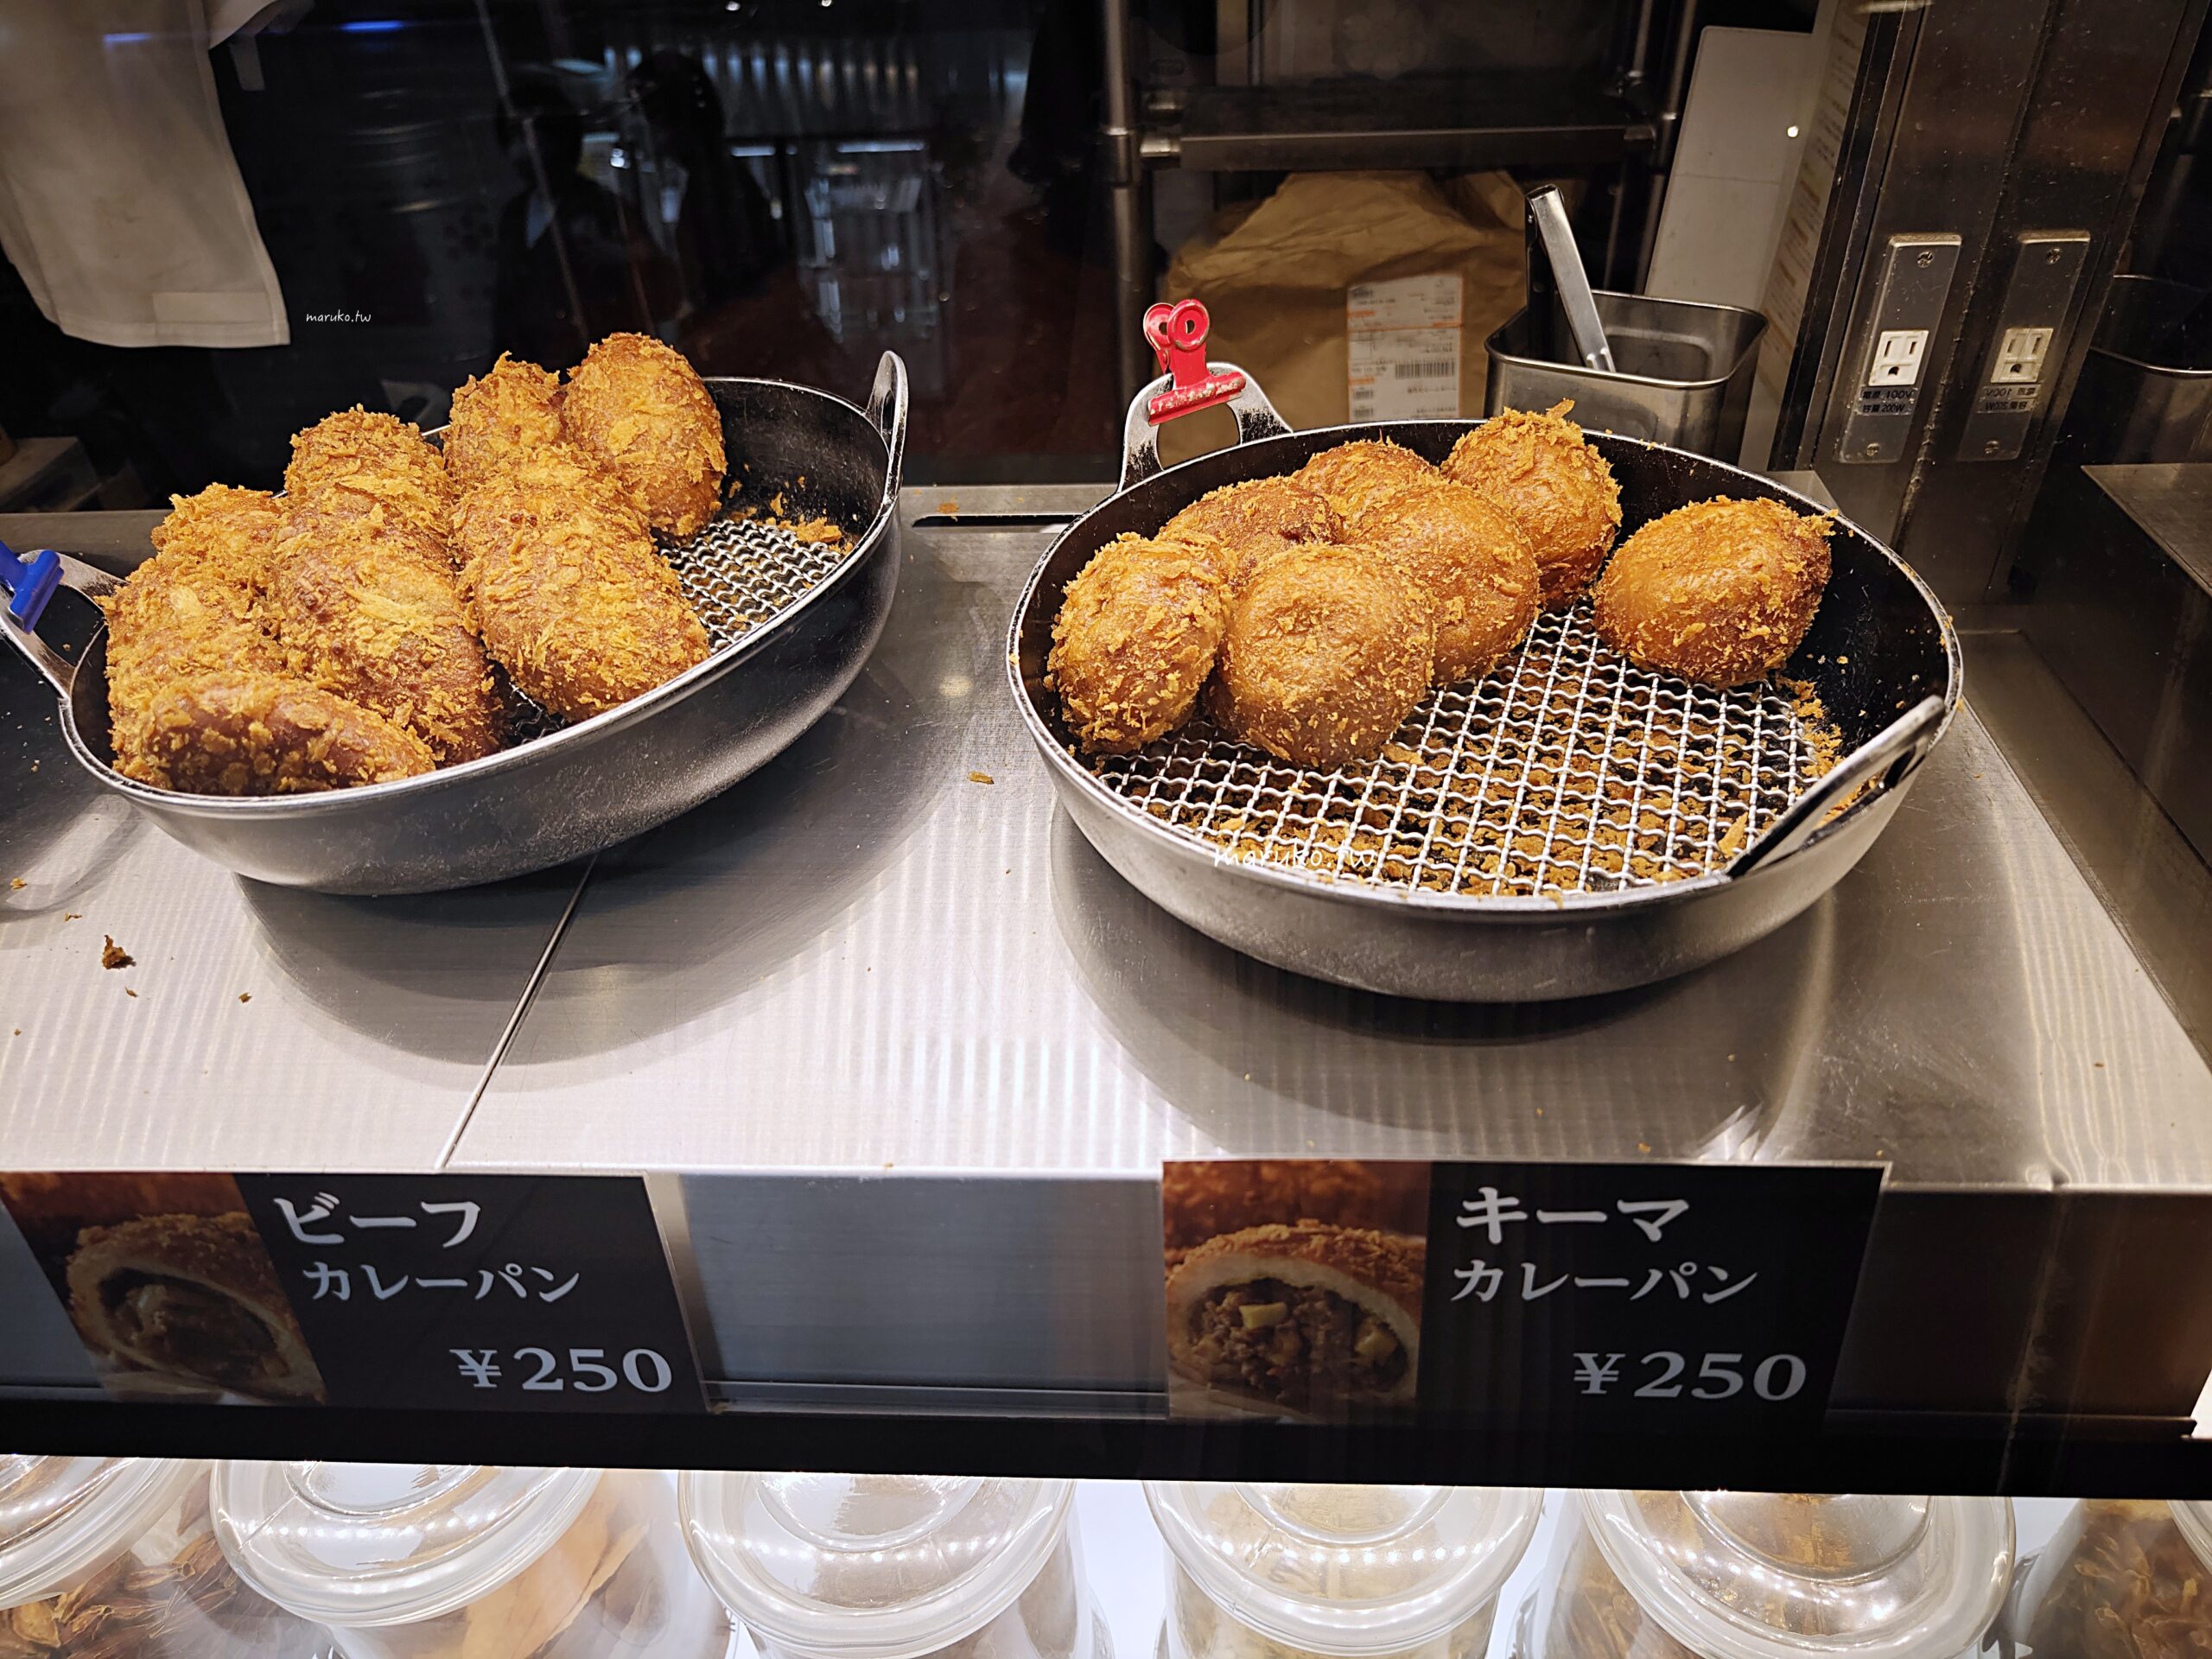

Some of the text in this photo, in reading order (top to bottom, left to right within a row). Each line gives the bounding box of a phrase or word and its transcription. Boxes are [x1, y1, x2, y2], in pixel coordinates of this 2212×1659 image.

[1886, 390, 1915, 399] 100V
[273, 1192, 481, 1248] ビーフ
[1456, 1186, 1690, 1245] キーマ
[303, 1262, 580, 1302] カレーパン
[1451, 1259, 1758, 1304] カレーパン
[449, 1347, 673, 1393] ¥250
[1573, 1351, 1807, 1401] ¥250
